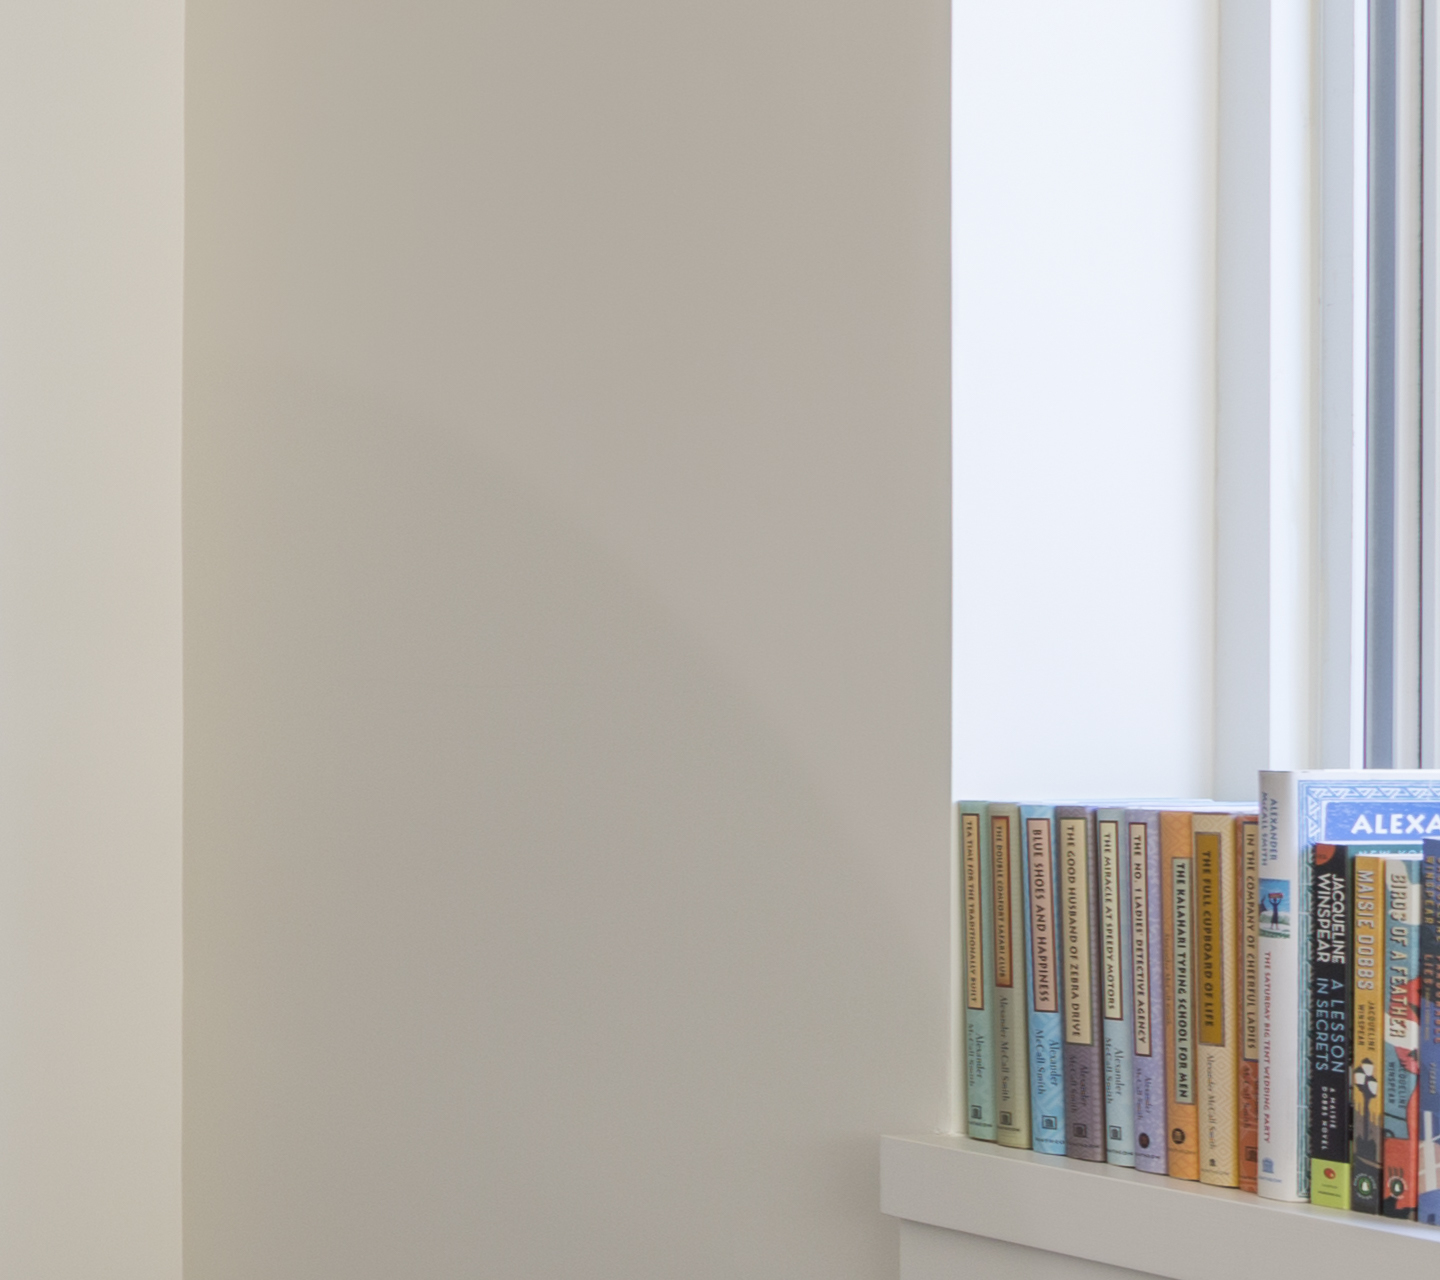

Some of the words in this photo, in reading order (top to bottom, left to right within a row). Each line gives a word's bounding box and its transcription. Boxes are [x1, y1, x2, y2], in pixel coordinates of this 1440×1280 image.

[1176, 890, 1188, 950] KALAHARI
[1202, 878, 1213, 907] FULL
[1315, 873, 1331, 962] WINSPEAR
[1331, 874, 1345, 964] JACQUELINE
[1356, 869, 1375, 930] MAISIE
[1177, 953, 1188, 995] TYPING
[1202, 911, 1214, 980] CUPBOARD
[1357, 934, 1375, 990] DOBBS
[1177, 998, 1189, 1044] SCHOOL
[1315, 999, 1329, 1071] SECRETS
